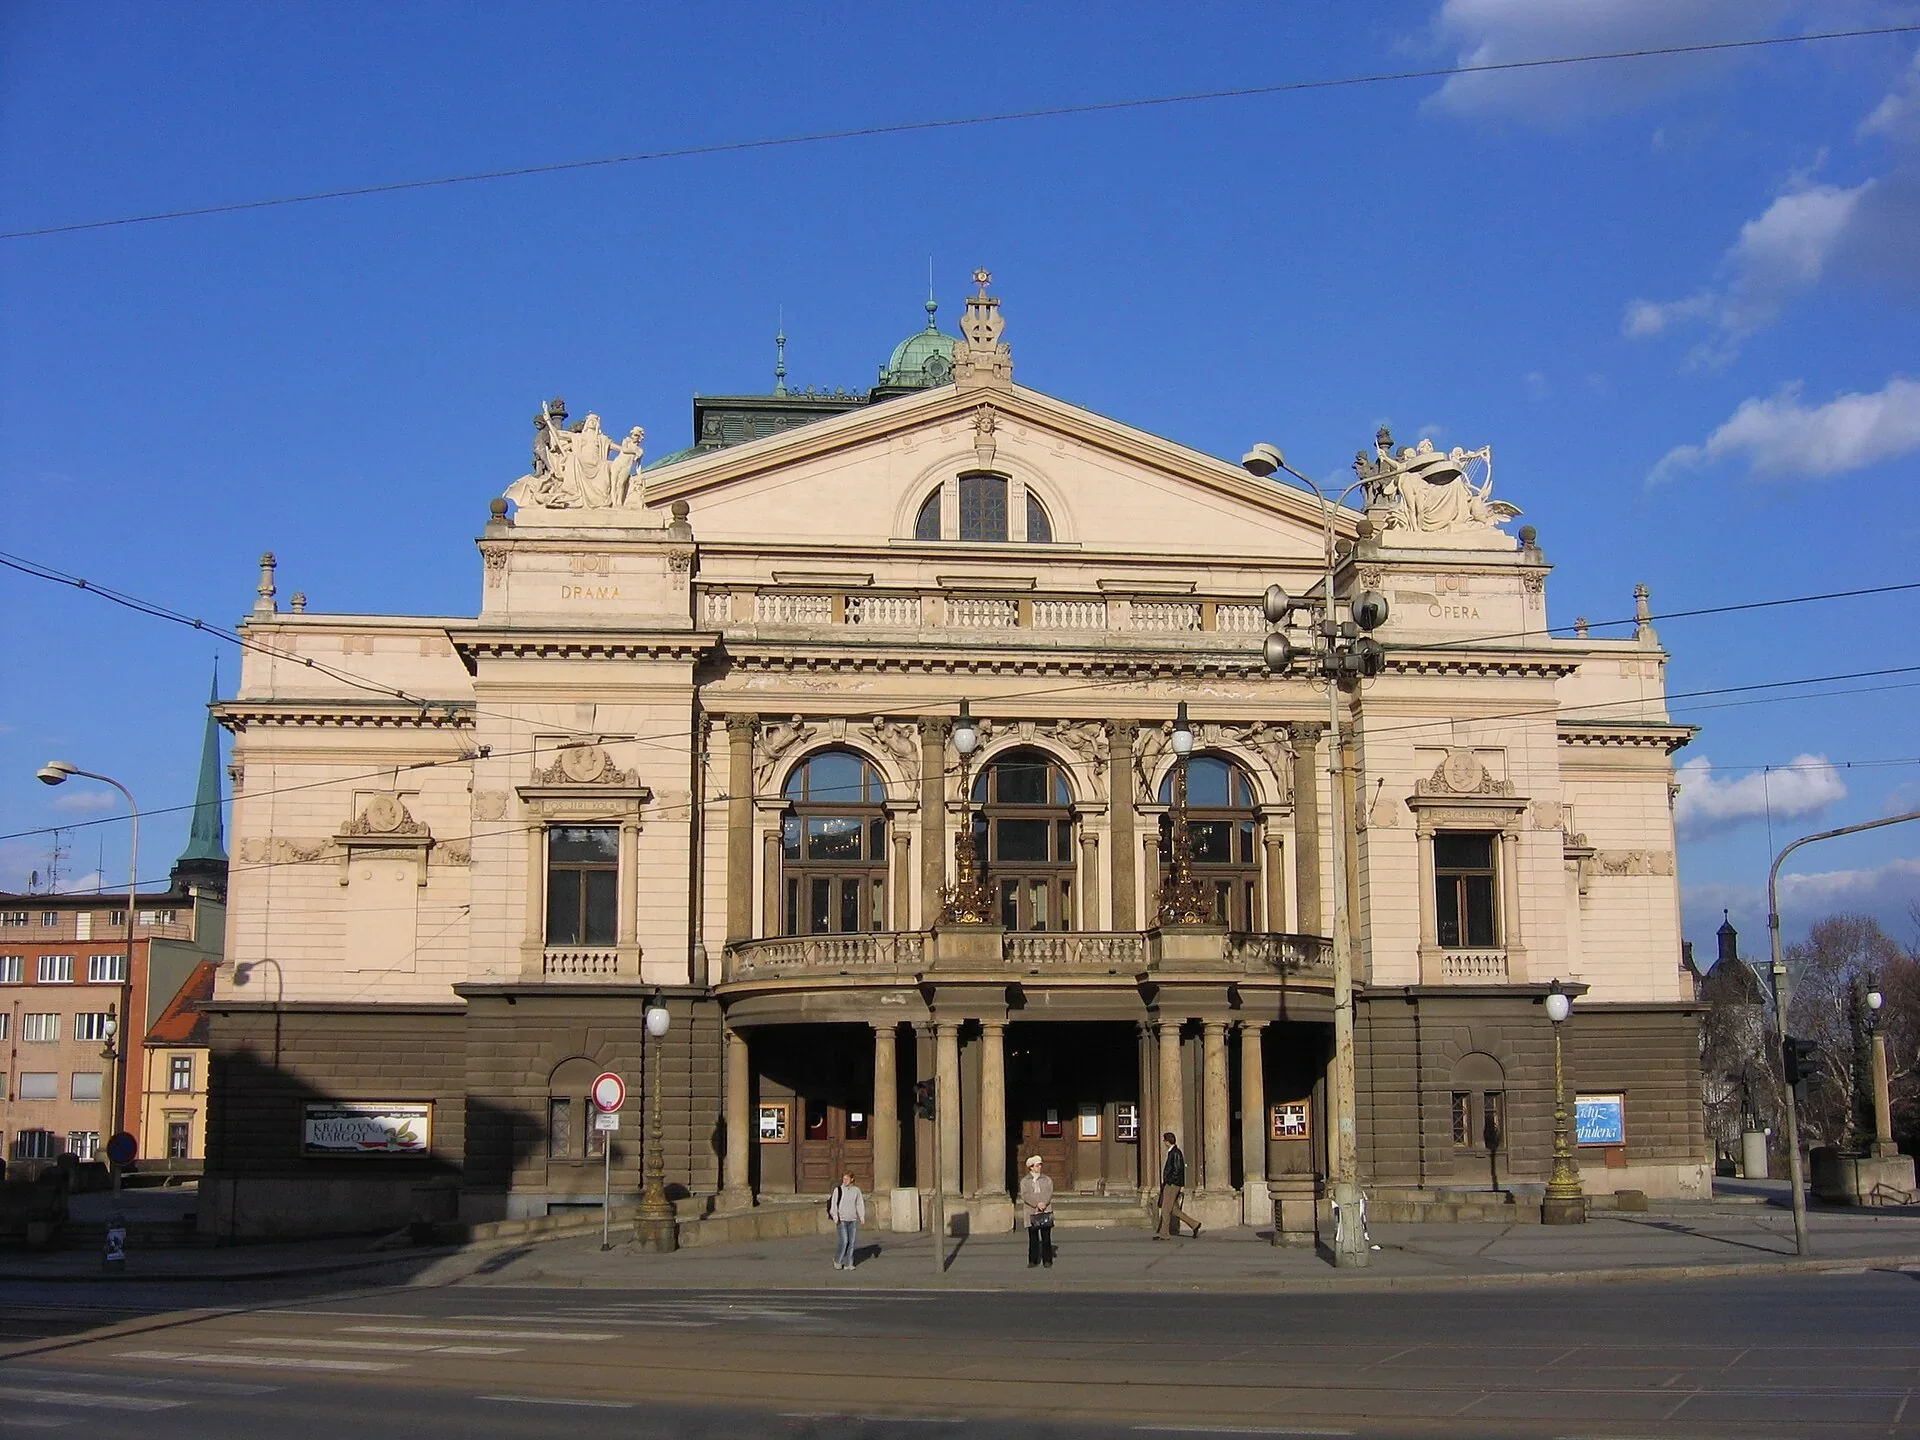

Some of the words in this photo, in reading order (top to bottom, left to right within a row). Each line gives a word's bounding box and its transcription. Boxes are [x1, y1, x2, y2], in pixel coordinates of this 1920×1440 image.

[561, 585, 620, 599] DRAMA
[1428, 603, 1480, 619] OPERA
[313, 1132, 366, 1142] MARGOT
